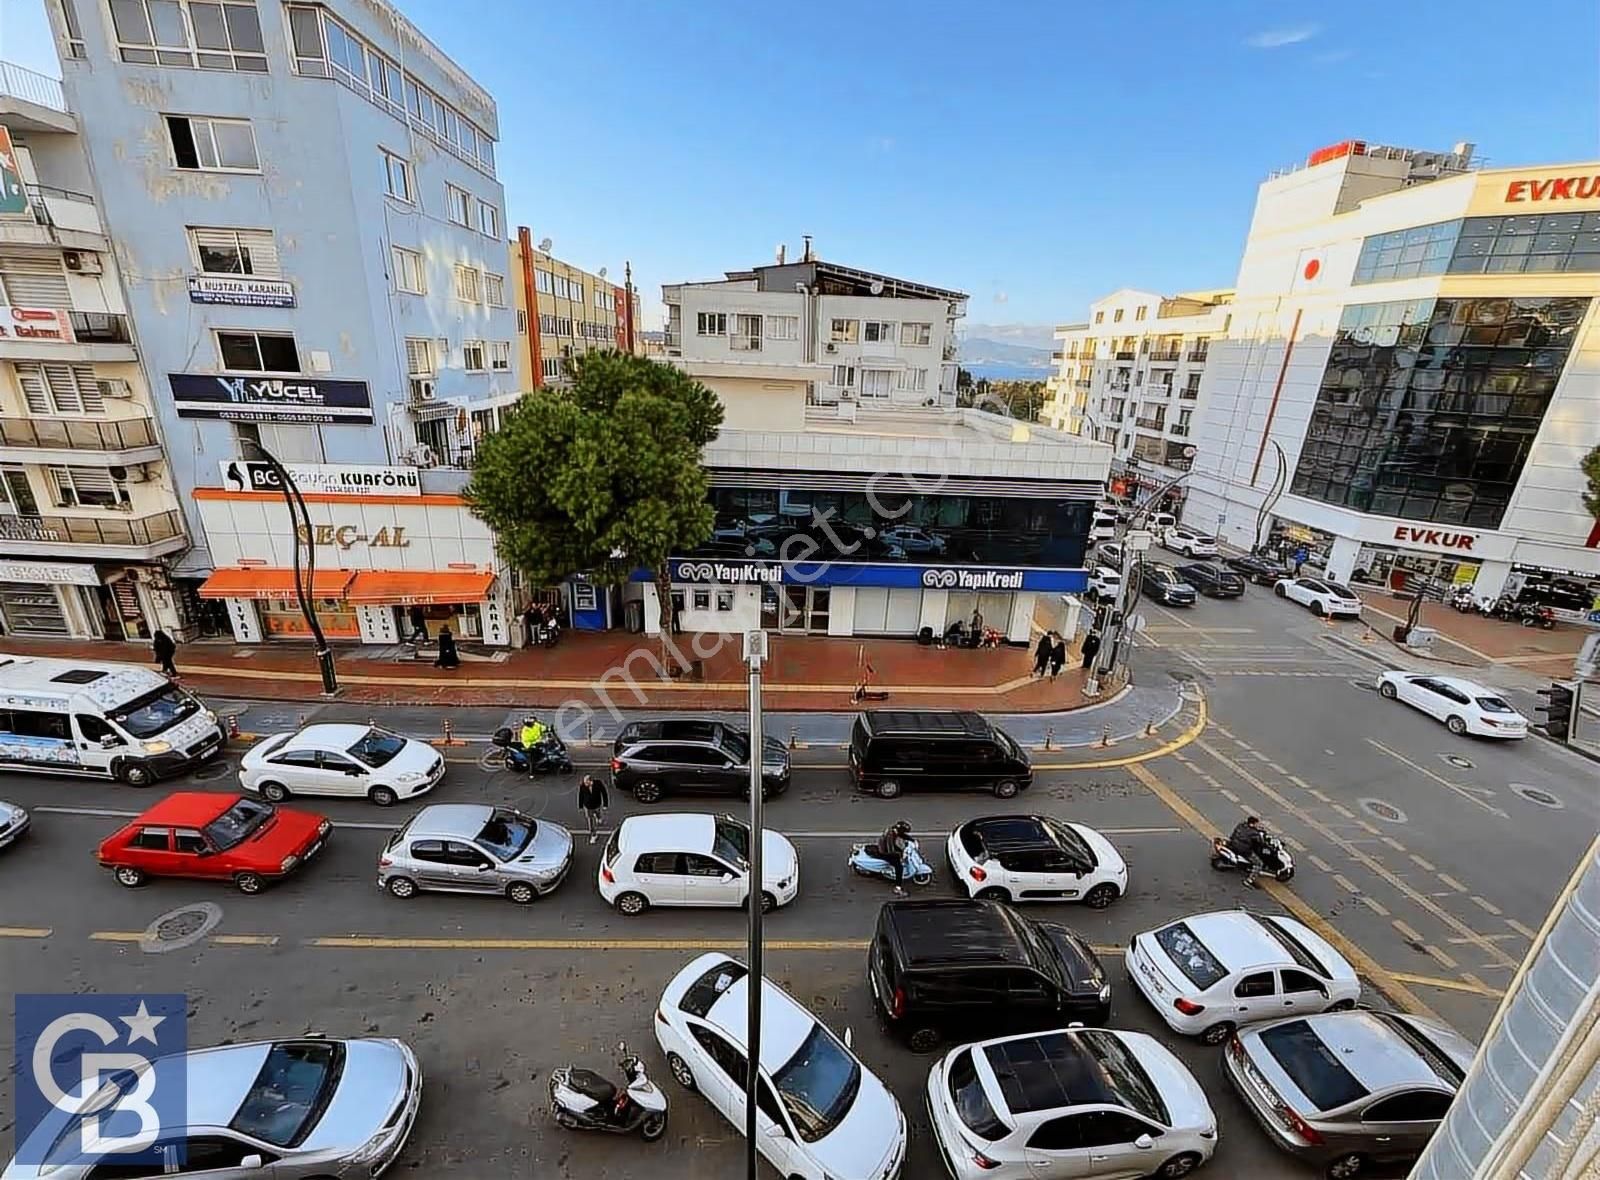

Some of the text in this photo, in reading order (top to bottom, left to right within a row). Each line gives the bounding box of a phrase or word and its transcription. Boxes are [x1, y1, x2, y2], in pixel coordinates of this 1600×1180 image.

[1504, 176, 1600, 203] EVKU
[340, 470, 417, 487] KUAFÖRÜ
[298, 524, 410, 550] SEÇ-AL
[1394, 527, 1475, 550] EVKUR
